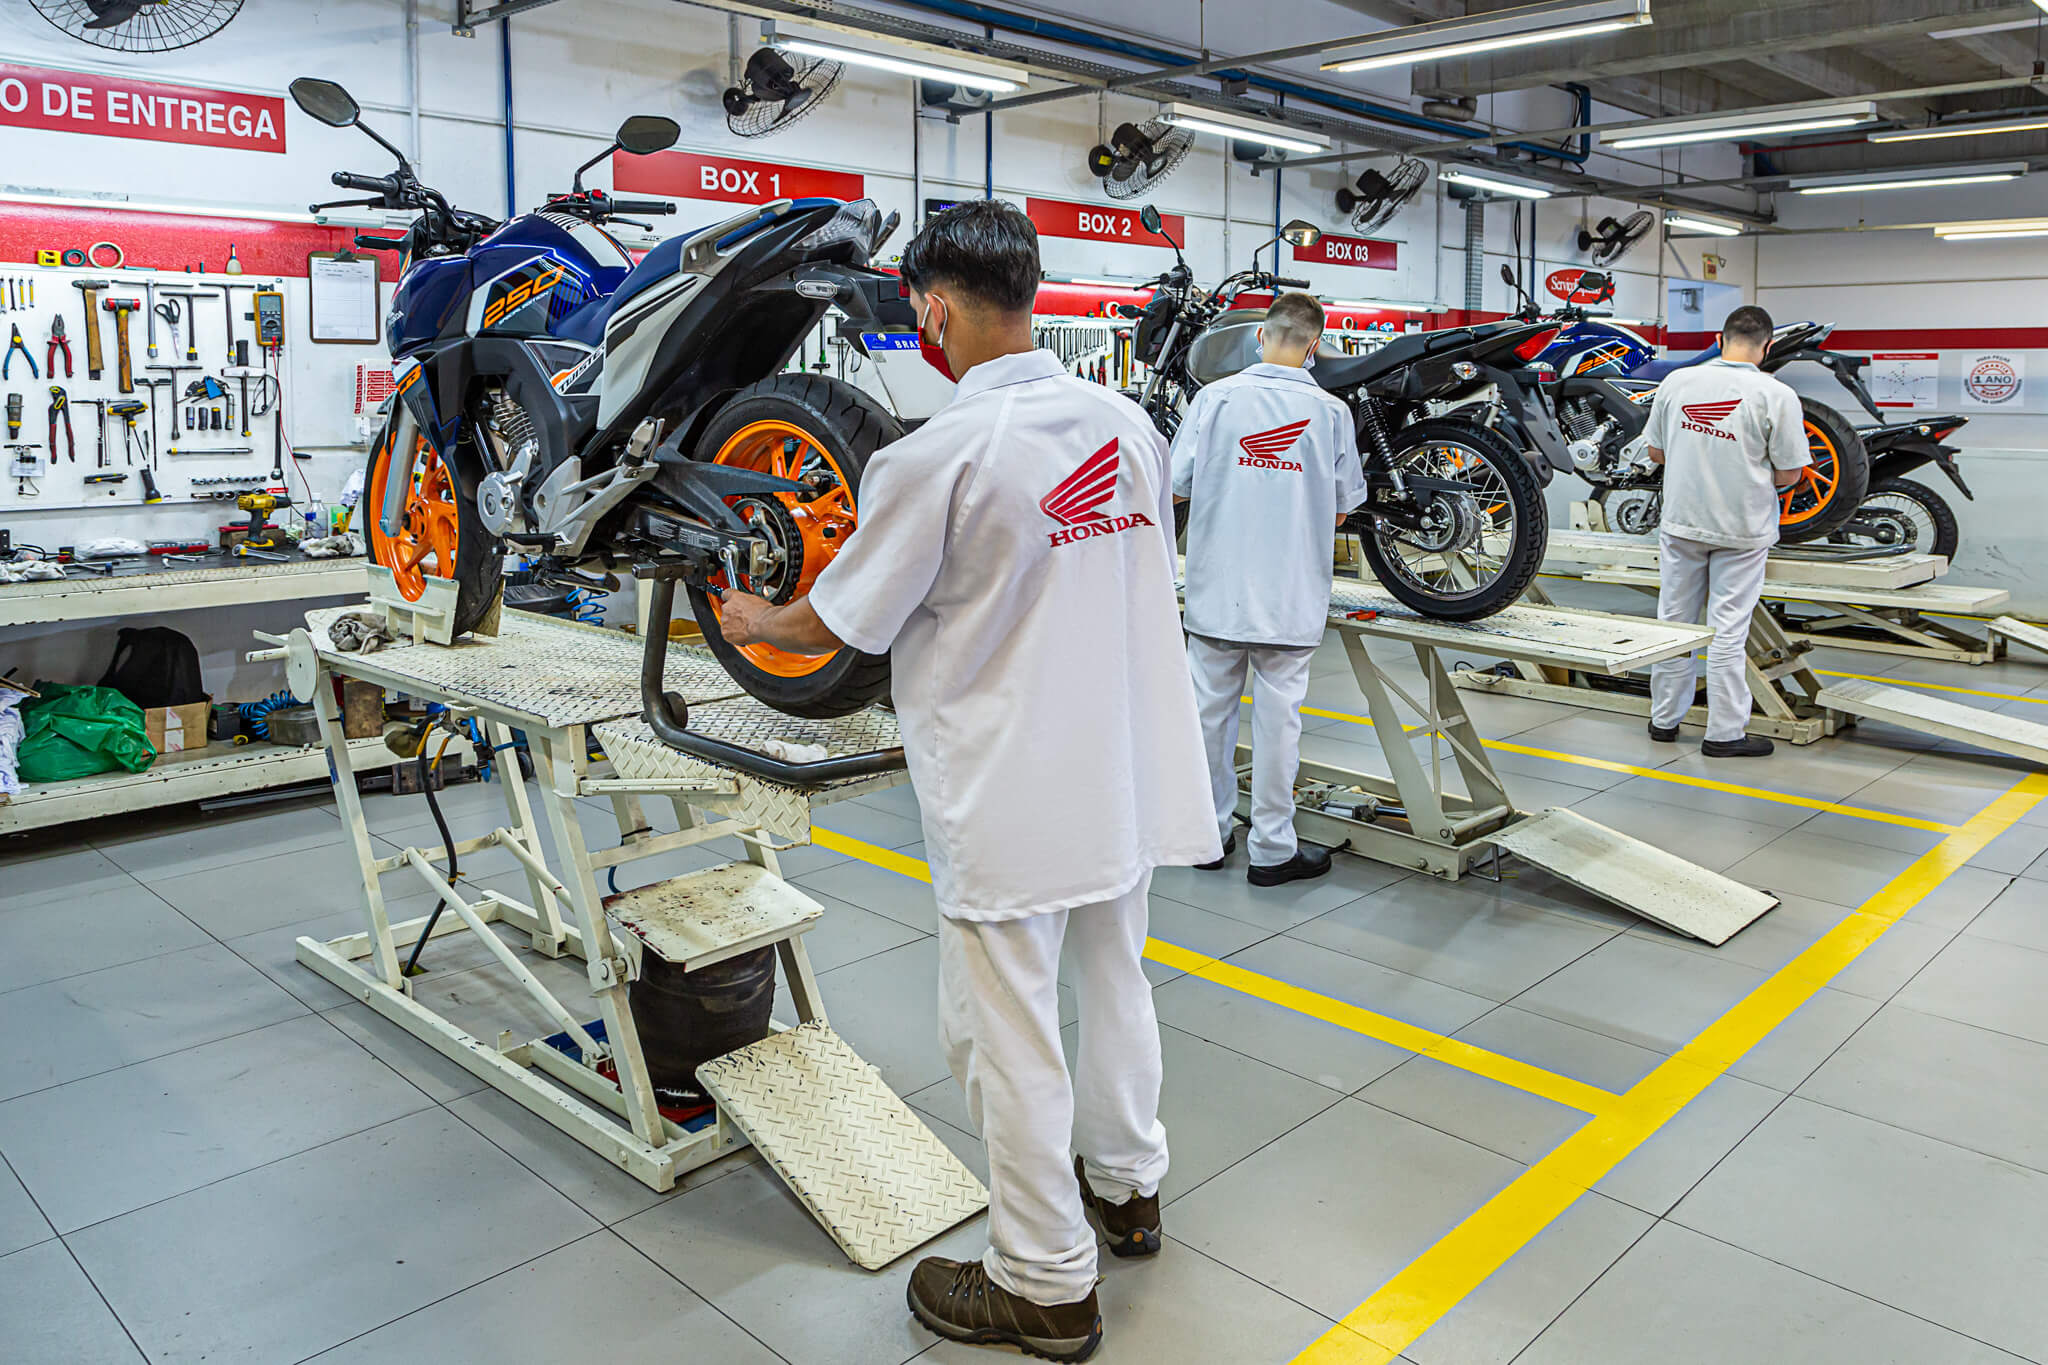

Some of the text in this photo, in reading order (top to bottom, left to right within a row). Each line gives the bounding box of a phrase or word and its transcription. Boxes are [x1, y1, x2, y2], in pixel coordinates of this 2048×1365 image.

[42, 83, 95, 121] DE
[107, 90, 278, 140] ENTREGA
[701, 165, 780, 197] BOX 1
[1079, 212, 1132, 237] BOX 2
[1326, 241, 1369, 262] BOX 03
[484, 265, 565, 329] 250
[1576, 346, 1629, 375] 250
[1974, 375, 2012, 384] 1 ANO
[1680, 421, 1738, 442] HONDA
[1238, 457, 1303, 472] HONDA
[1047, 512, 1156, 548] HONDA
